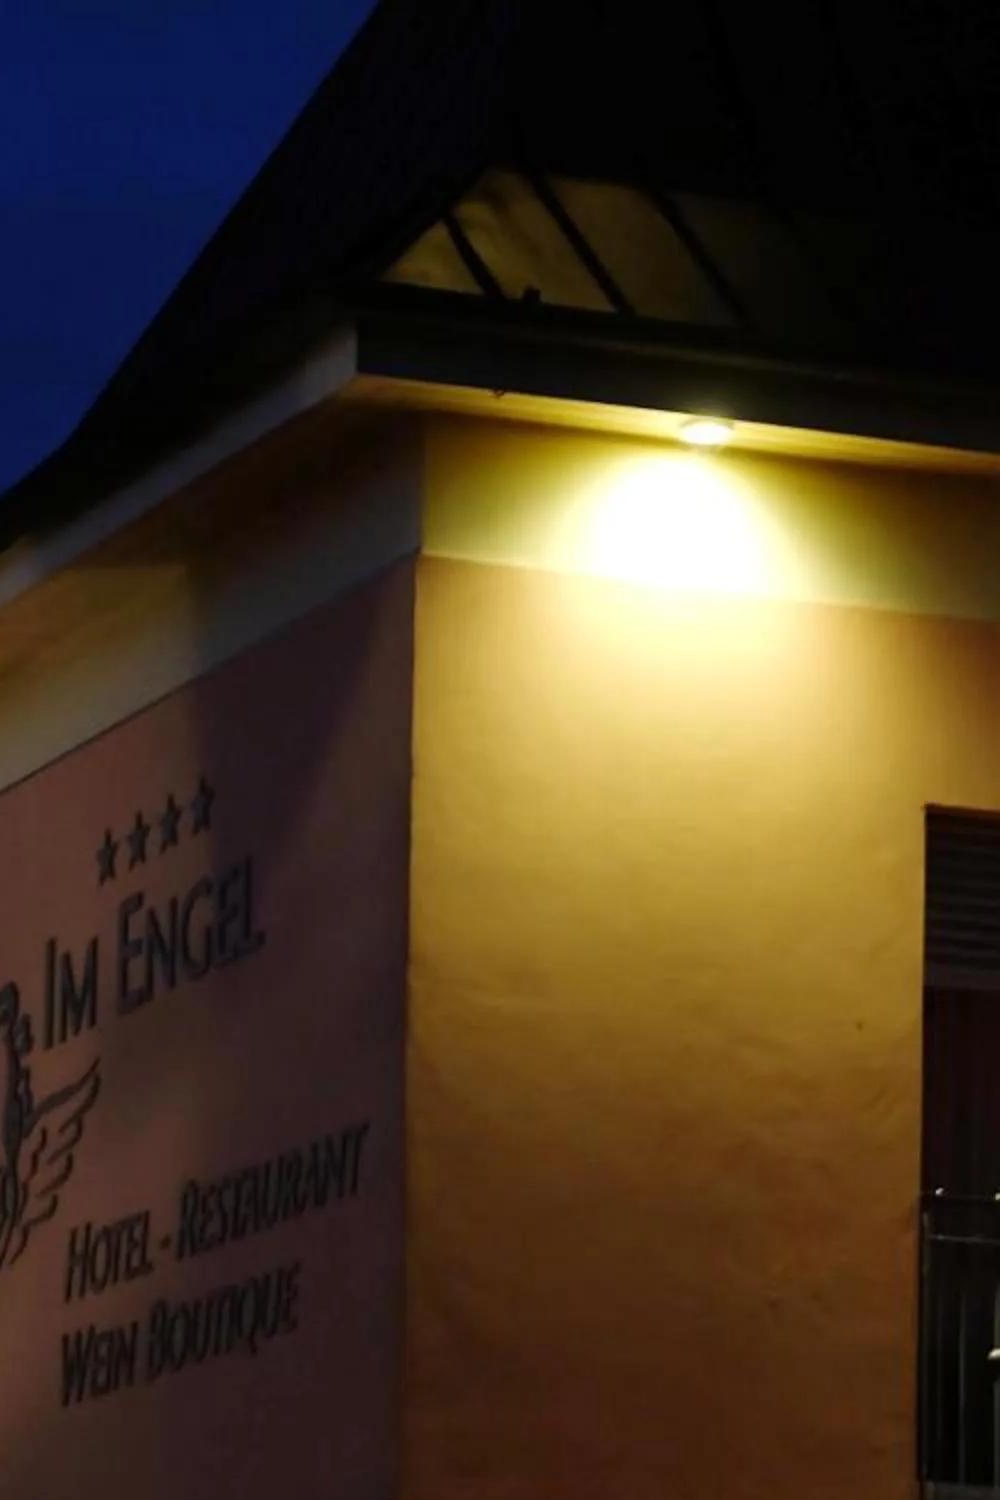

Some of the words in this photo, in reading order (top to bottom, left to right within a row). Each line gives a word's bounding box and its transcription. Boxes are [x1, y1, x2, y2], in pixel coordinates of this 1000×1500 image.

[42, 936, 99, 1052] IM
[116, 855, 266, 1015] ENGEL
[65, 1210, 154, 1302] HOTEL
[177, 1122, 371, 1260] RESTAURANT
[60, 1314, 138, 1406] WEIN
[148, 1262, 303, 1383] BOUTIQUE
